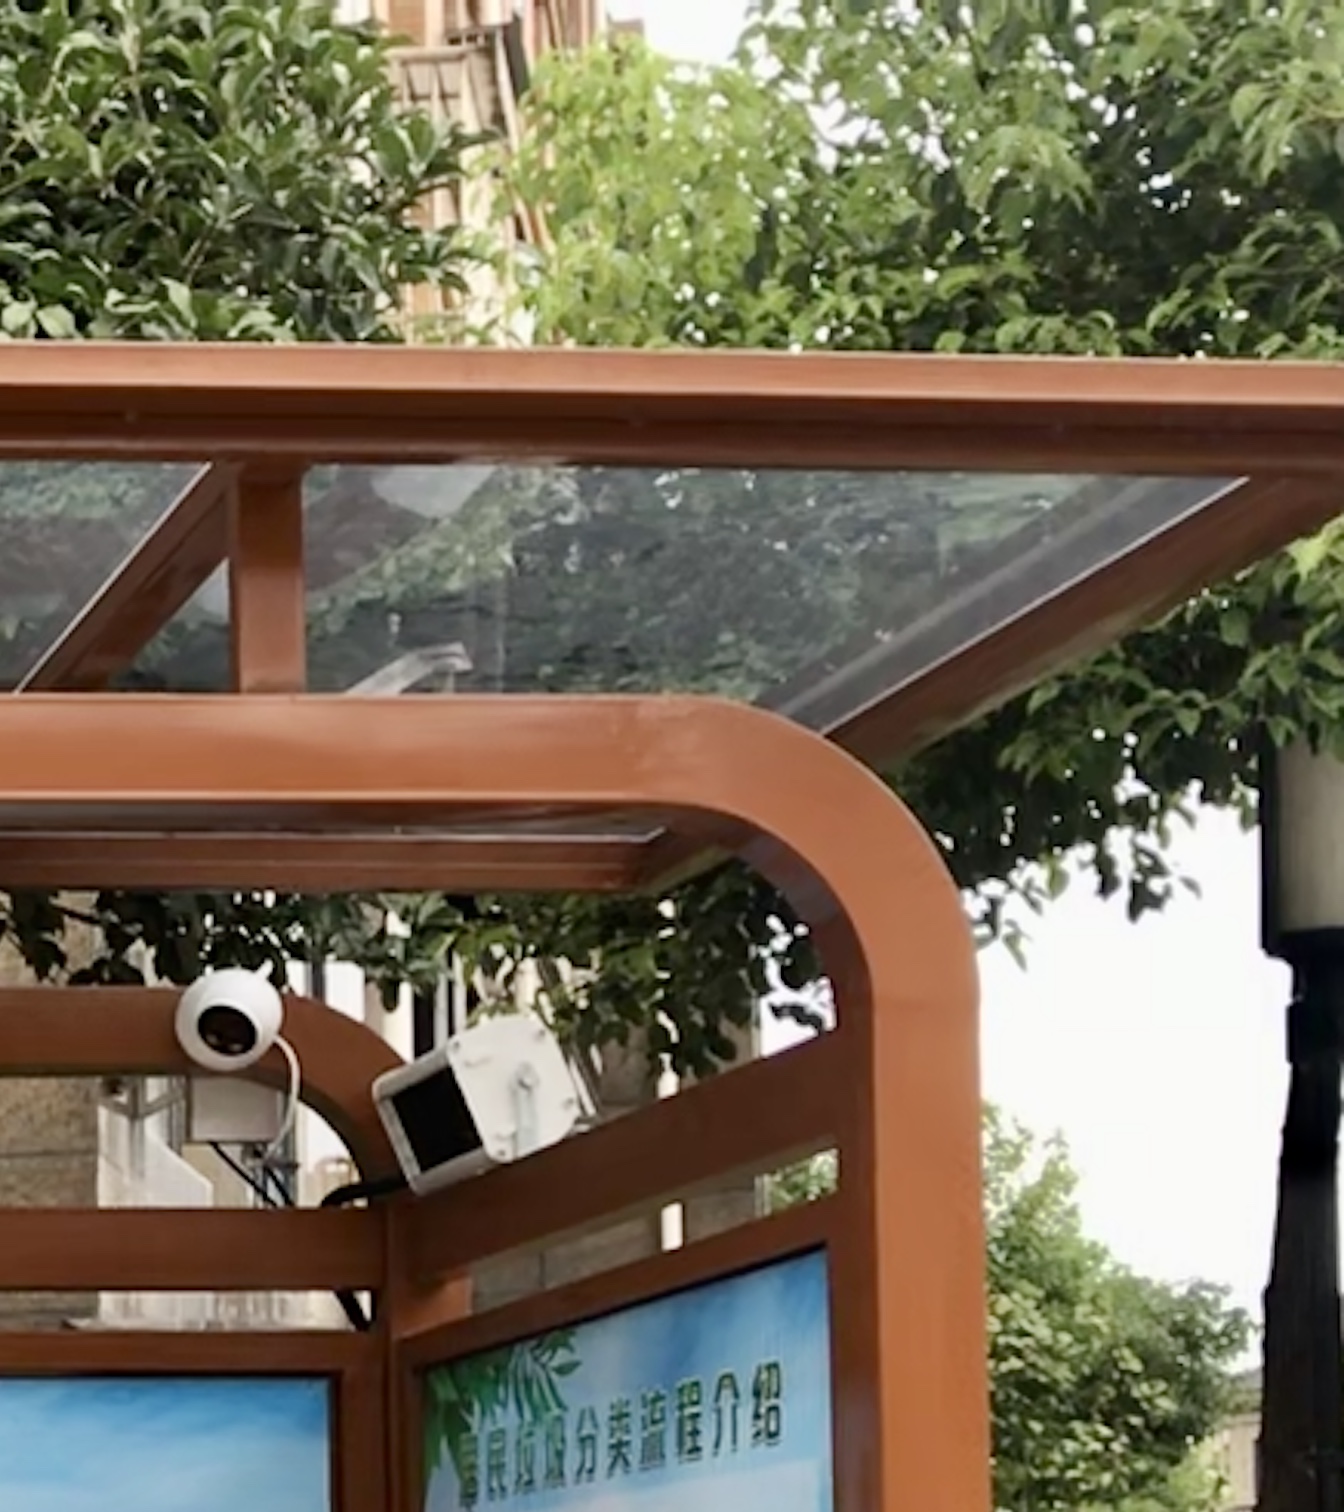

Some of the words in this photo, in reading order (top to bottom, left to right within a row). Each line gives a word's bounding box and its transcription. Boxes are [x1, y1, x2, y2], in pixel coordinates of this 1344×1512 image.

[458, 1362, 782, 1512] 居民垃圾分类流程介绍
